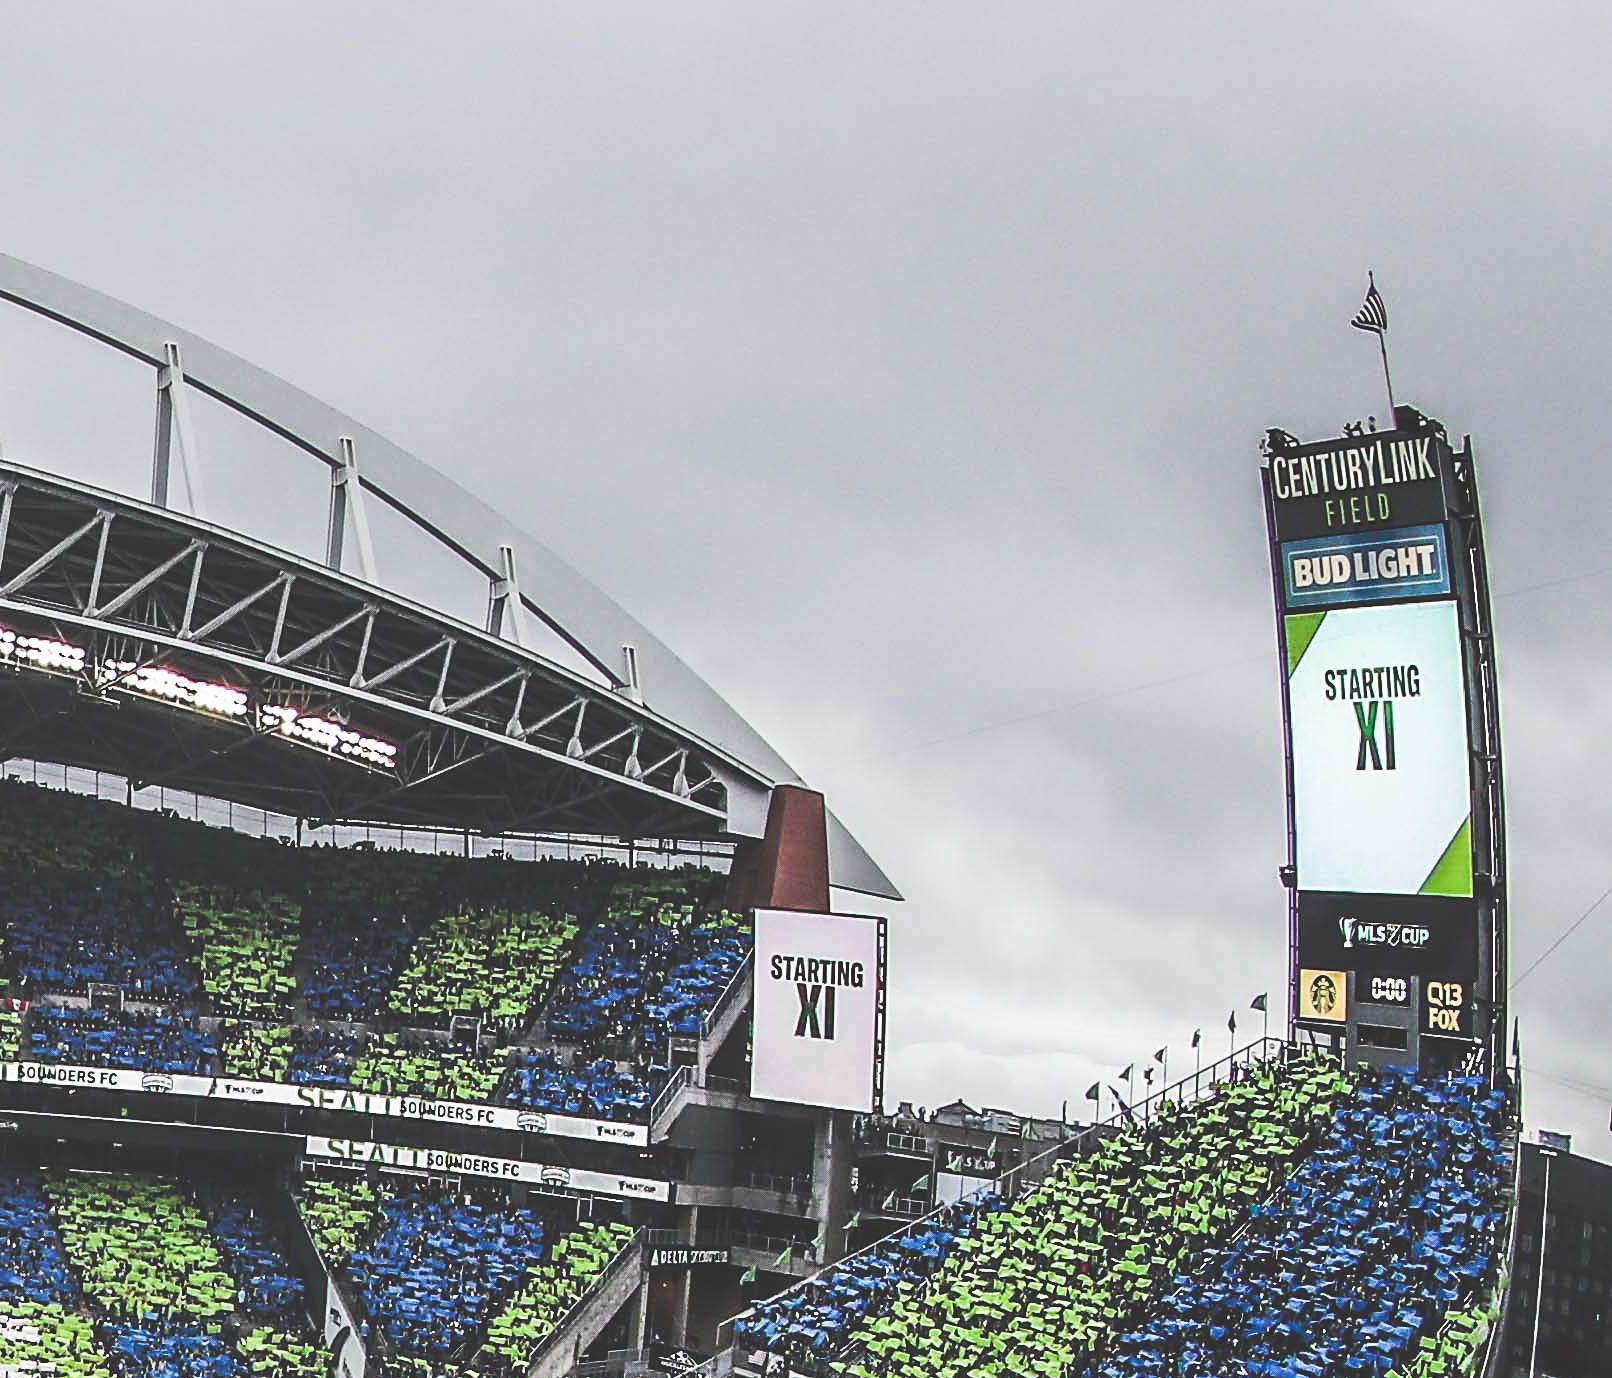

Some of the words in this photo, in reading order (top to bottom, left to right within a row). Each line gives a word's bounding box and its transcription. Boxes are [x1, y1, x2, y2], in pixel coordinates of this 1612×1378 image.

[1273, 437, 1436, 499] CENTURYLINK
[1325, 493, 1390, 527] FIELD
[1293, 554, 1351, 588] BUD
[1354, 545, 1435, 581] LIGHT
[1324, 664, 1421, 701] STARTING
[1353, 701, 1396, 770] XI
[1358, 925, 1386, 942] MLS
[1402, 928, 1429, 945] CUP
[770, 954, 864, 988] STARTING
[1371, 977, 1407, 1002] 0:00
[1427, 982, 1463, 1007] Q13
[794, 982, 836, 1040] XI
[1429, 1008, 1461, 1032] FOX
[17, 1064, 95, 1085] SOUNDERS
[100, 1071, 118, 1085] FC
[400, 1099, 474, 1121] SOUNDERS
[477, 1107, 494, 1123] FC
[427, 1151, 499, 1176] SOUNDERS
[502, 1159, 519, 1177] FC
[660, 1250, 687, 1264] DELTA
